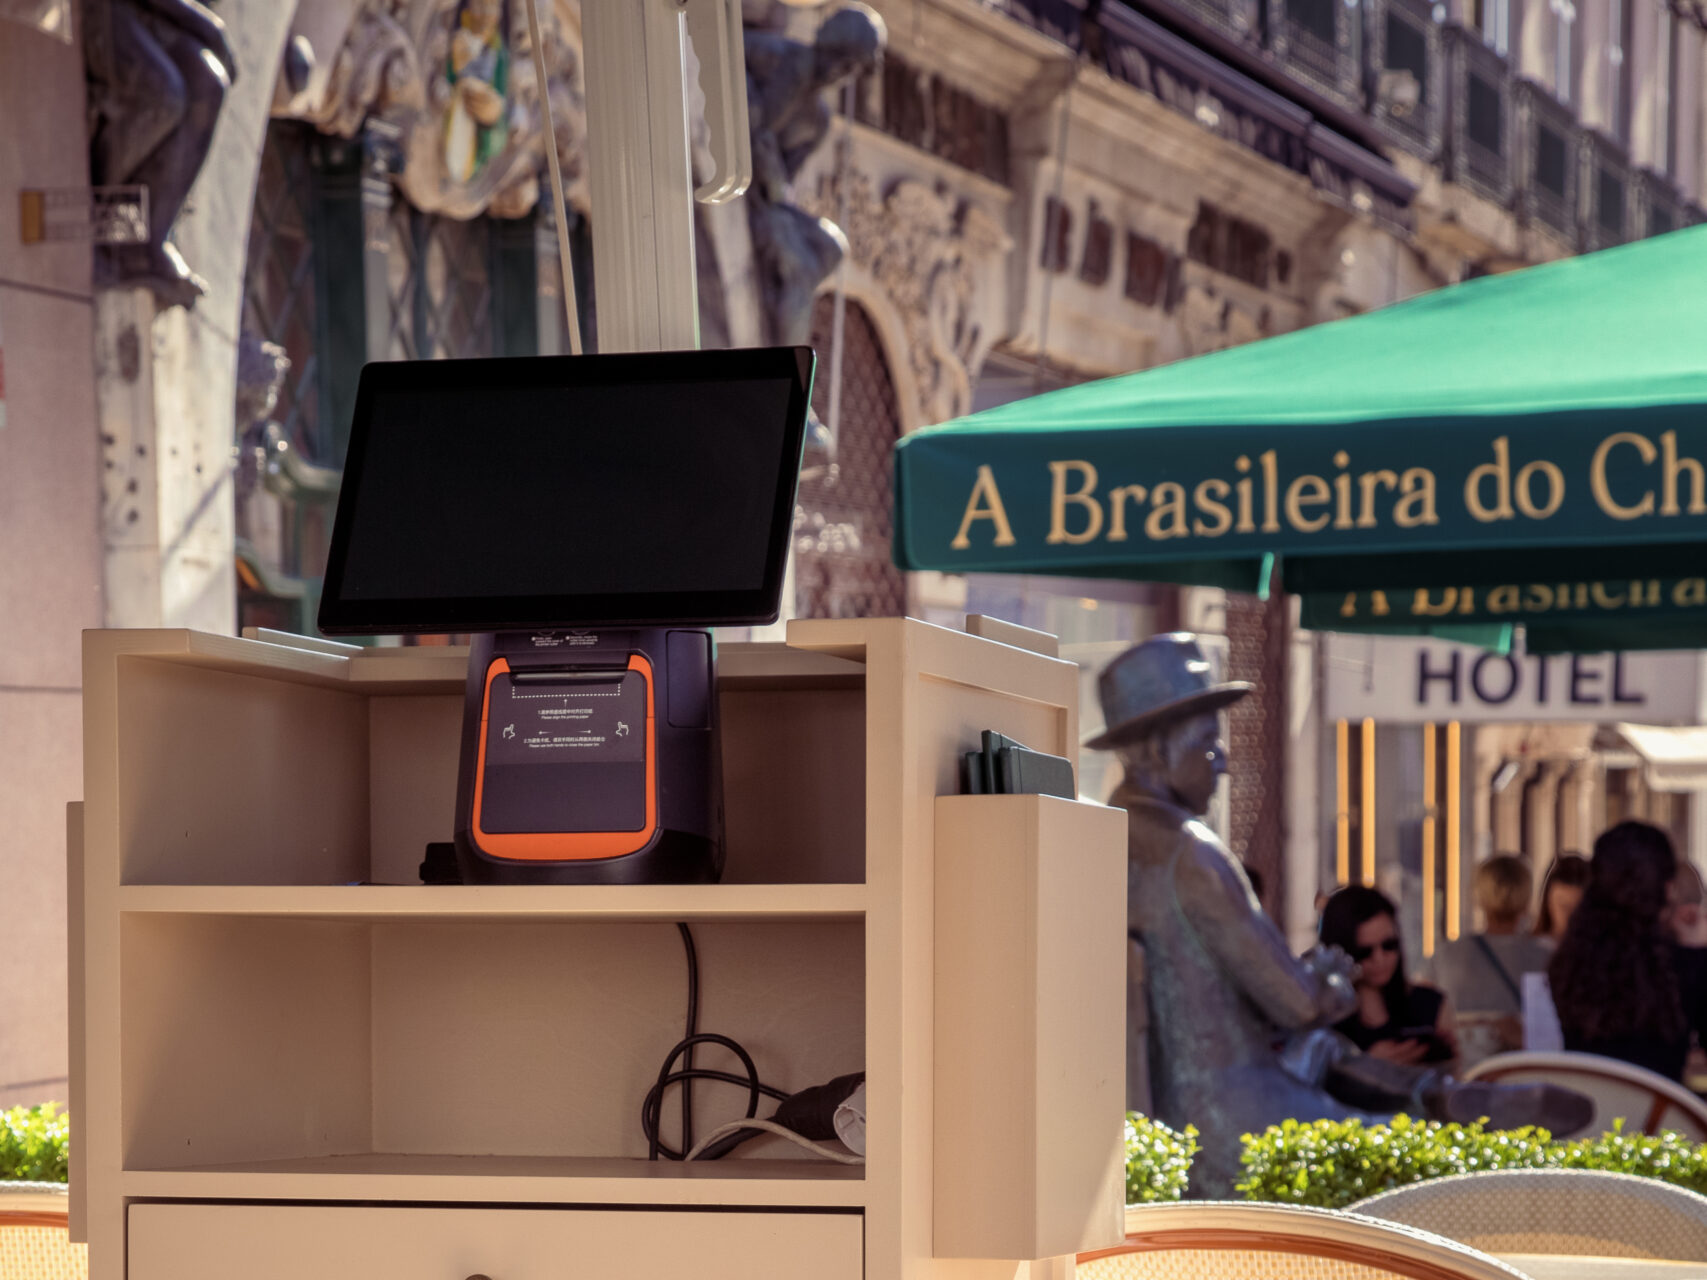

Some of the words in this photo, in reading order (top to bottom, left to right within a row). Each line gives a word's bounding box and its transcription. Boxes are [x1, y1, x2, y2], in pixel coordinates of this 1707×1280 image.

[951, 465, 1016, 550] A
[1046, 450, 1438, 544] Brasileira
[1464, 436, 1565, 522] do
[1590, 429, 1707, 520] Ch
[1416, 649, 1646, 705] HOTEL
